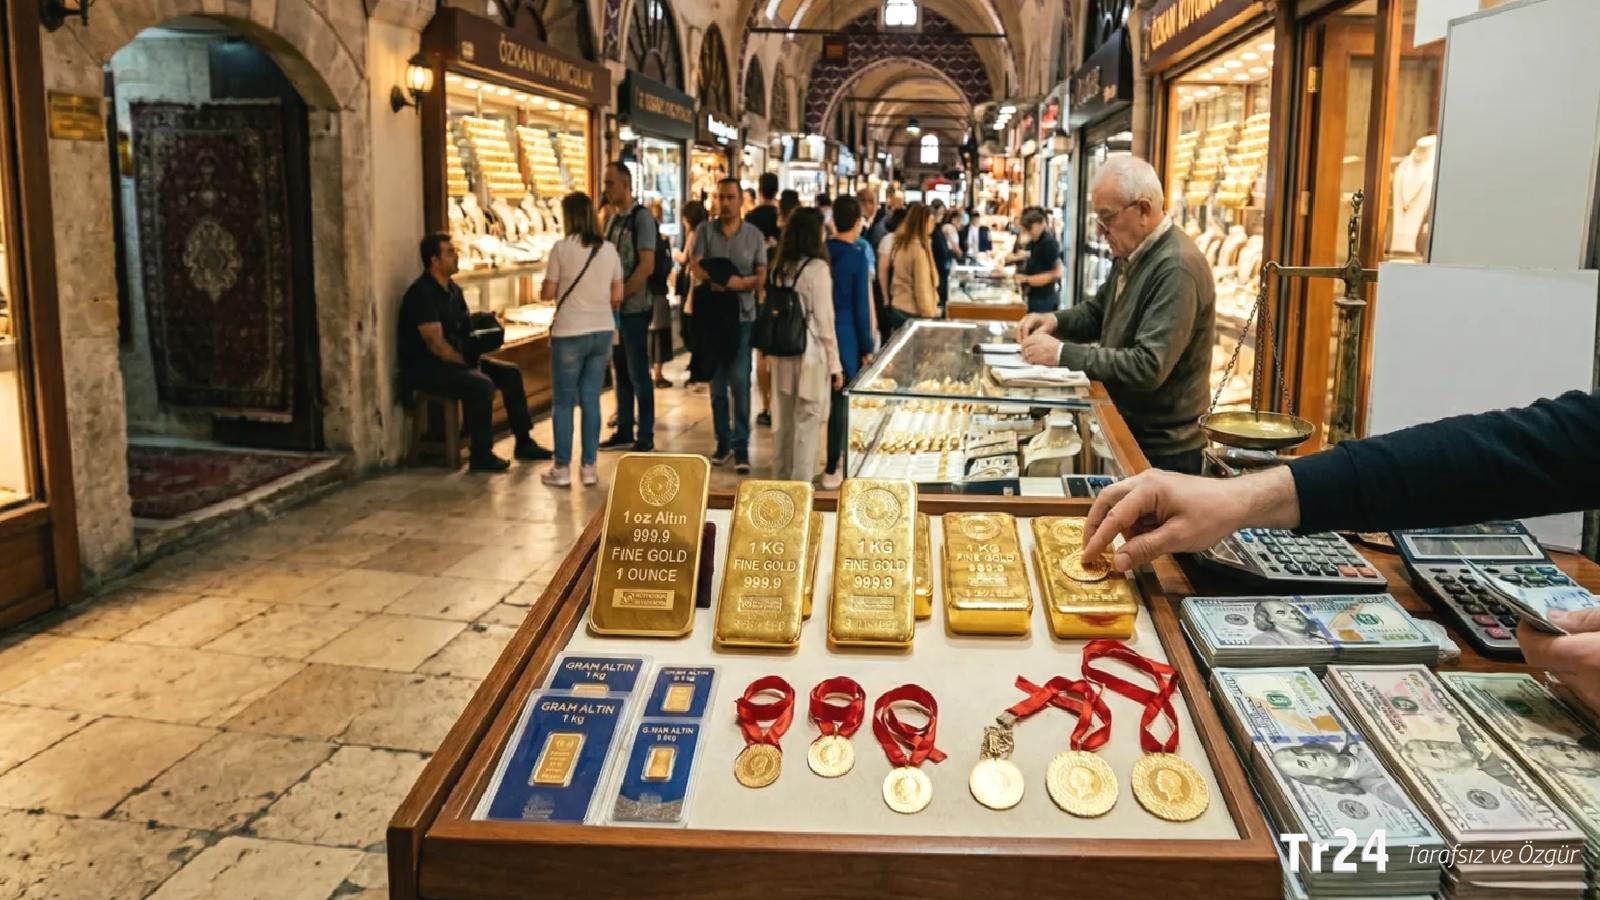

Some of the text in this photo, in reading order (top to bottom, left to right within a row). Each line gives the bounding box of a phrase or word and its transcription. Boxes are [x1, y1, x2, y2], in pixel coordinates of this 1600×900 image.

[499, 33, 535, 72] ÖZKAN
[623, 510, 631, 524] 1
[633, 512, 652, 524] oz
[750, 541, 785, 555] 1 KG
[858, 540, 894, 554] 1 KG
[611, 546, 687, 563] FINE GOLD
[734, 559, 797, 572] FINE GOLD
[843, 558, 906, 572] FINE GOLD
[616, 567, 678, 582] 1 OUNCE
[743, 576, 782, 589] 999.9
[854, 575, 893, 590] 999.9
[566, 662, 635, 672] GRAM ALTIN
[541, 702, 615, 714] GRAM ALTIN
[571, 715, 585, 726] kg
